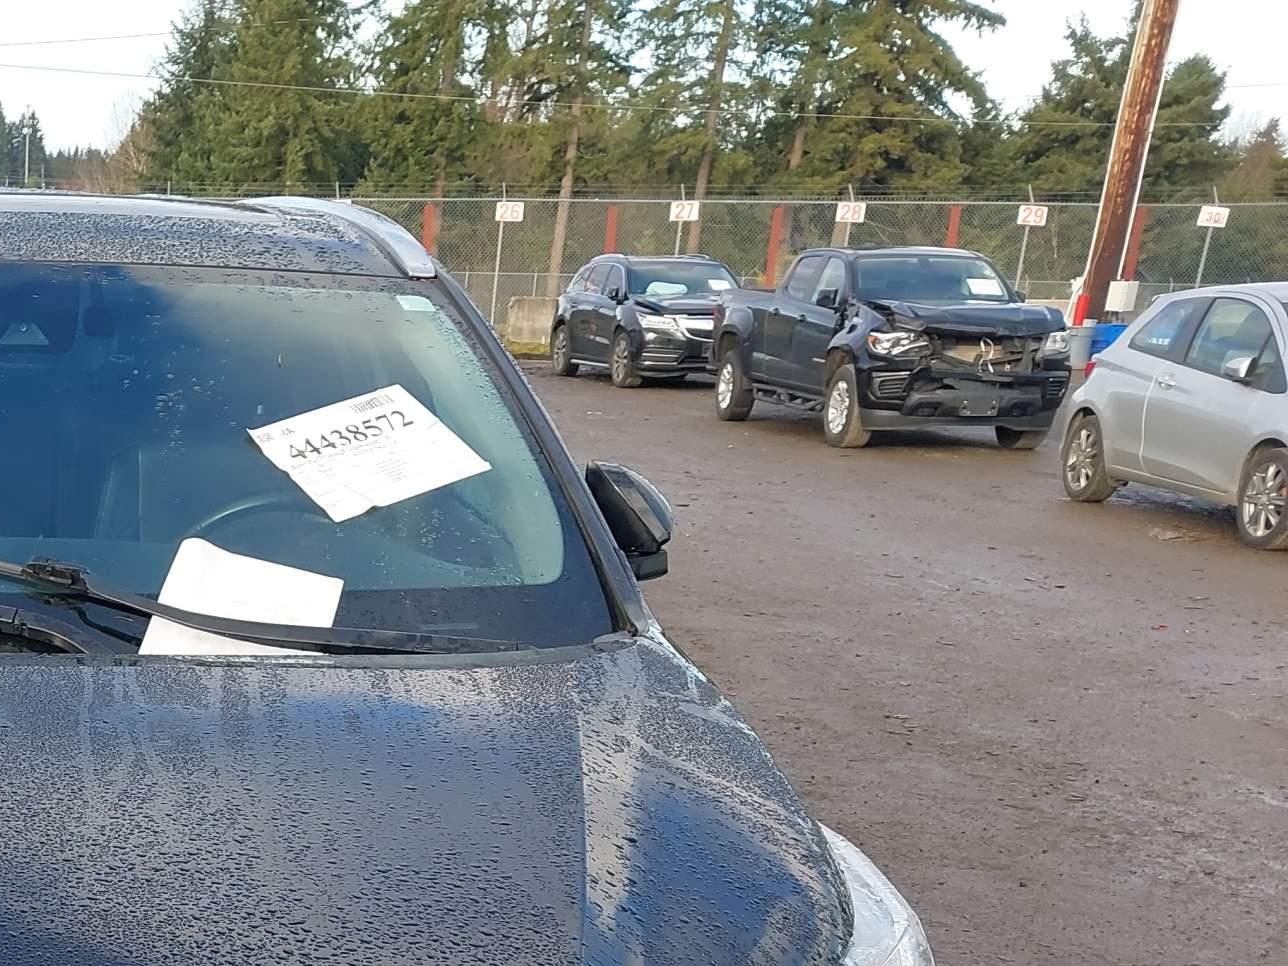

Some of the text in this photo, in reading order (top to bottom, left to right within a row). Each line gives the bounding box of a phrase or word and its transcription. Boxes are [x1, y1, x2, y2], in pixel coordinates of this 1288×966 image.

[499, 203, 521, 220] 26
[675, 202, 695, 219] 27
[840, 204, 862, 221] 28
[1021, 207, 1044, 224] 29
[1206, 211, 1222, 224] 30
[289, 410, 414, 459] 44438572
